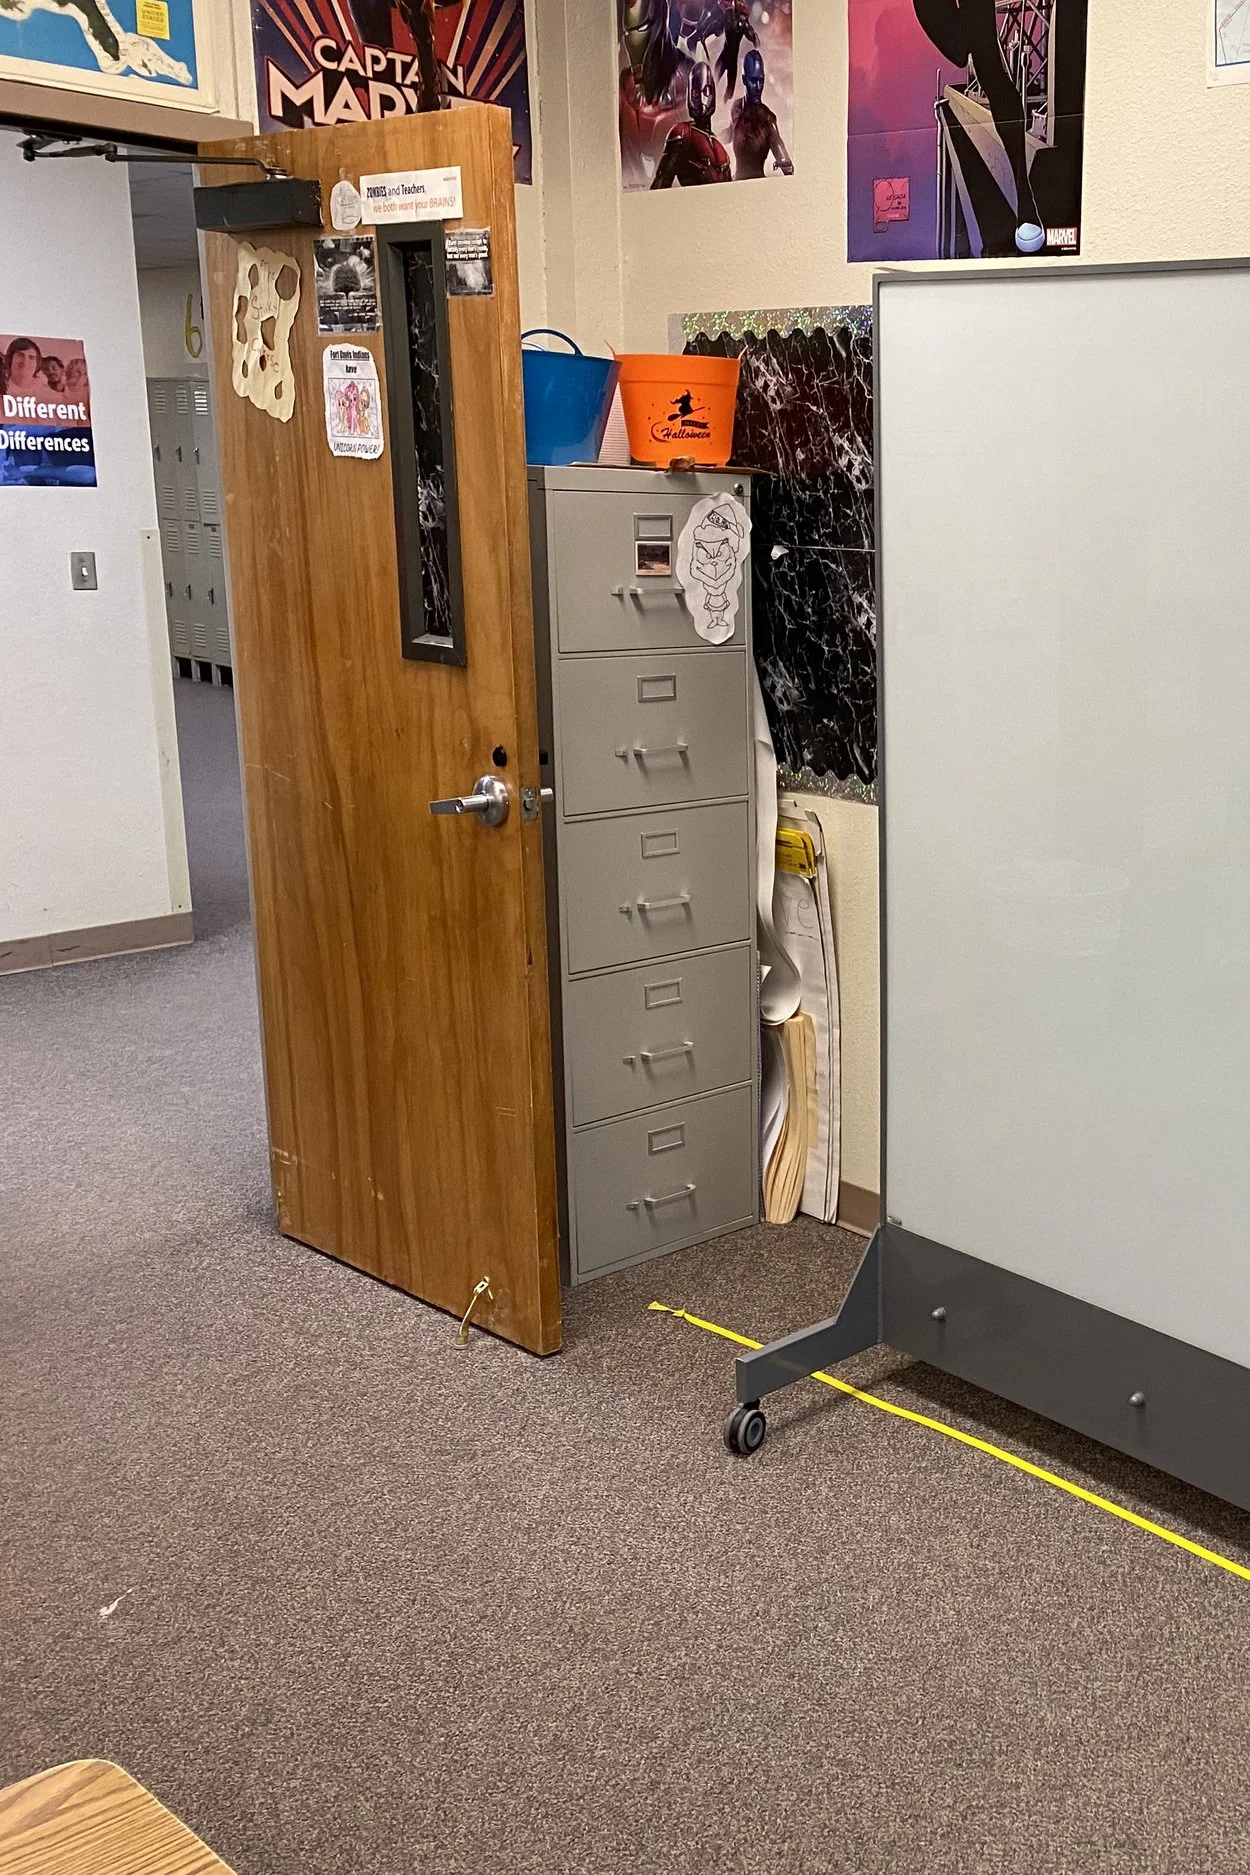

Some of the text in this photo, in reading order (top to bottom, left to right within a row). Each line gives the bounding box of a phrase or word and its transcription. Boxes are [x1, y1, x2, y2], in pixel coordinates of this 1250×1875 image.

[314, 37, 465, 94] CAPTAN
[366, 186, 387, 198] ZOMBIES
[388, 185, 400, 196] and
[373, 196, 456, 213] we both want your BRAINS!
[1046, 228, 1077, 246] MARVEL
[346, 364, 357, 373] have
[3, 395, 87, 421] Different
[0, 429, 90, 453] Differences
[660, 427, 711, 440] Halloween
